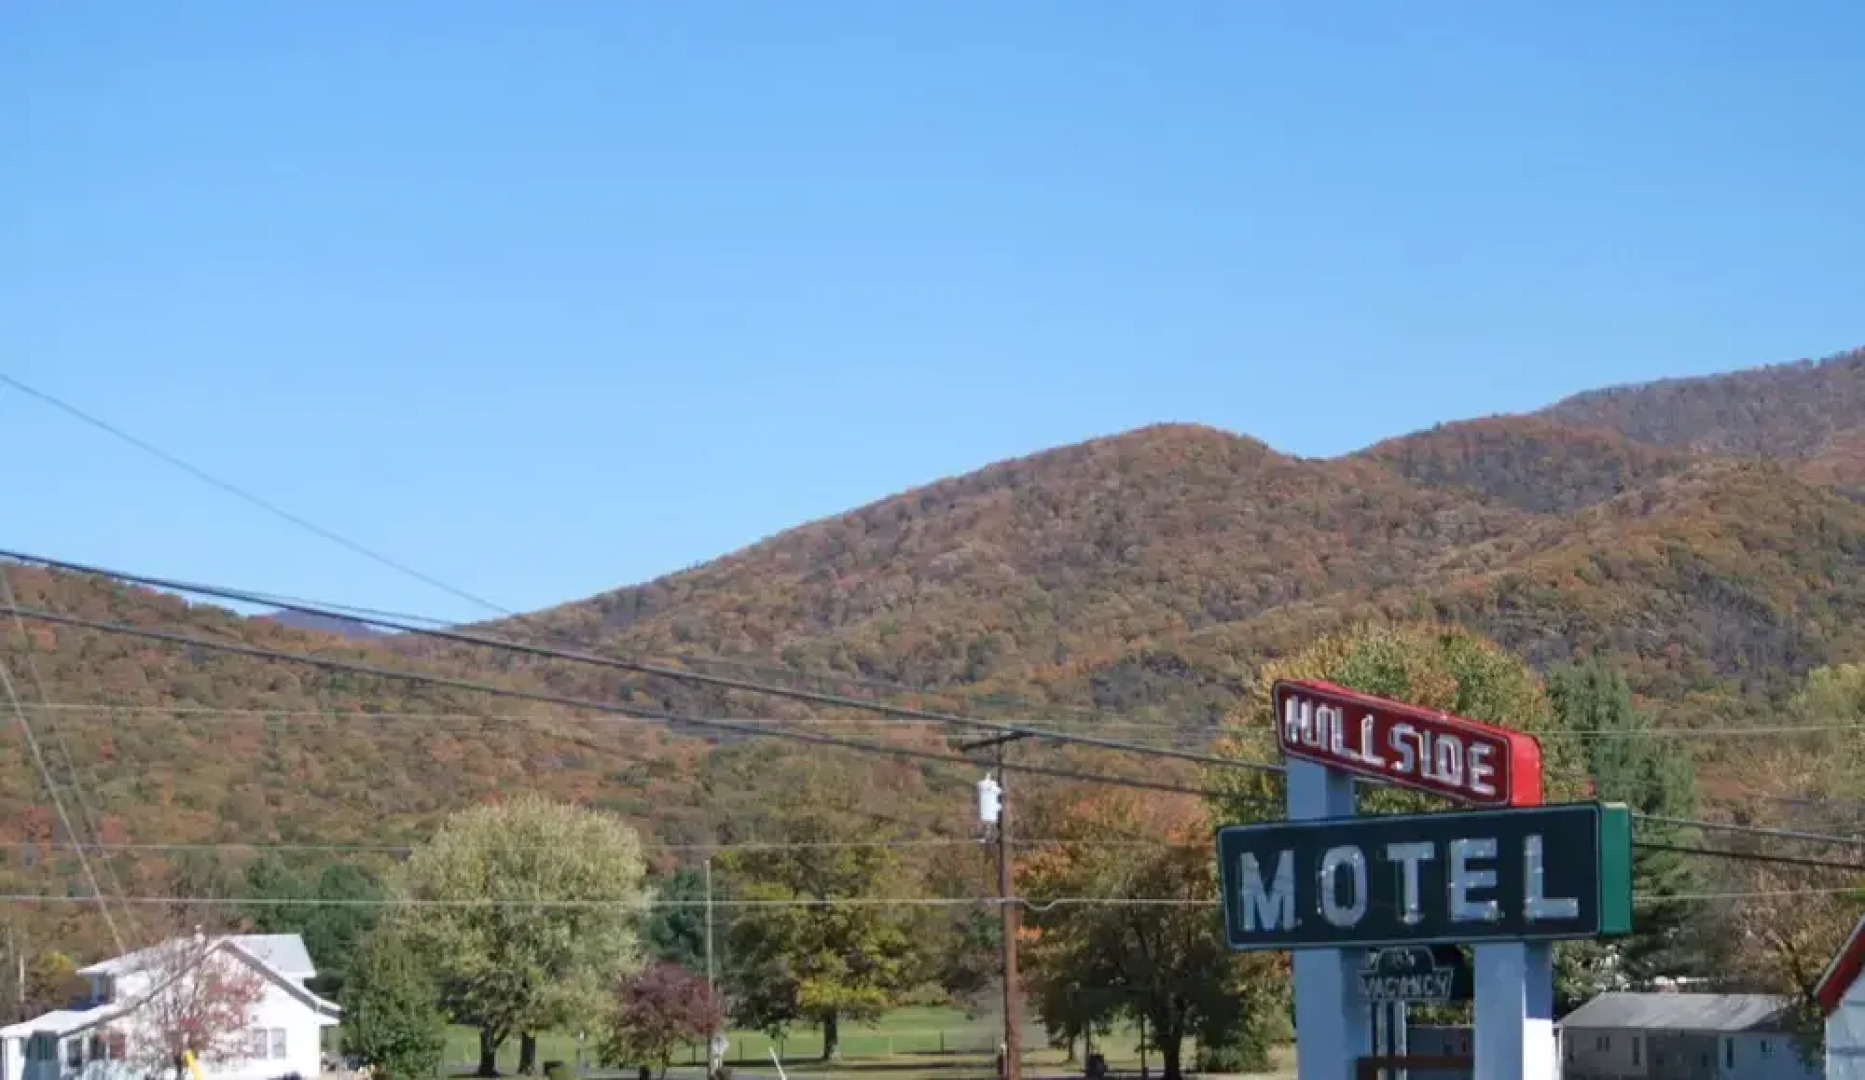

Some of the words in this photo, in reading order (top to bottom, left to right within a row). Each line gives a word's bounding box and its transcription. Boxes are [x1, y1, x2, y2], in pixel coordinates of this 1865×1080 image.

[1285, 695, 1496, 795] HILLSIDE
[1240, 834, 1580, 932] MOTEL
[1361, 974, 1450, 998] VACANCY
